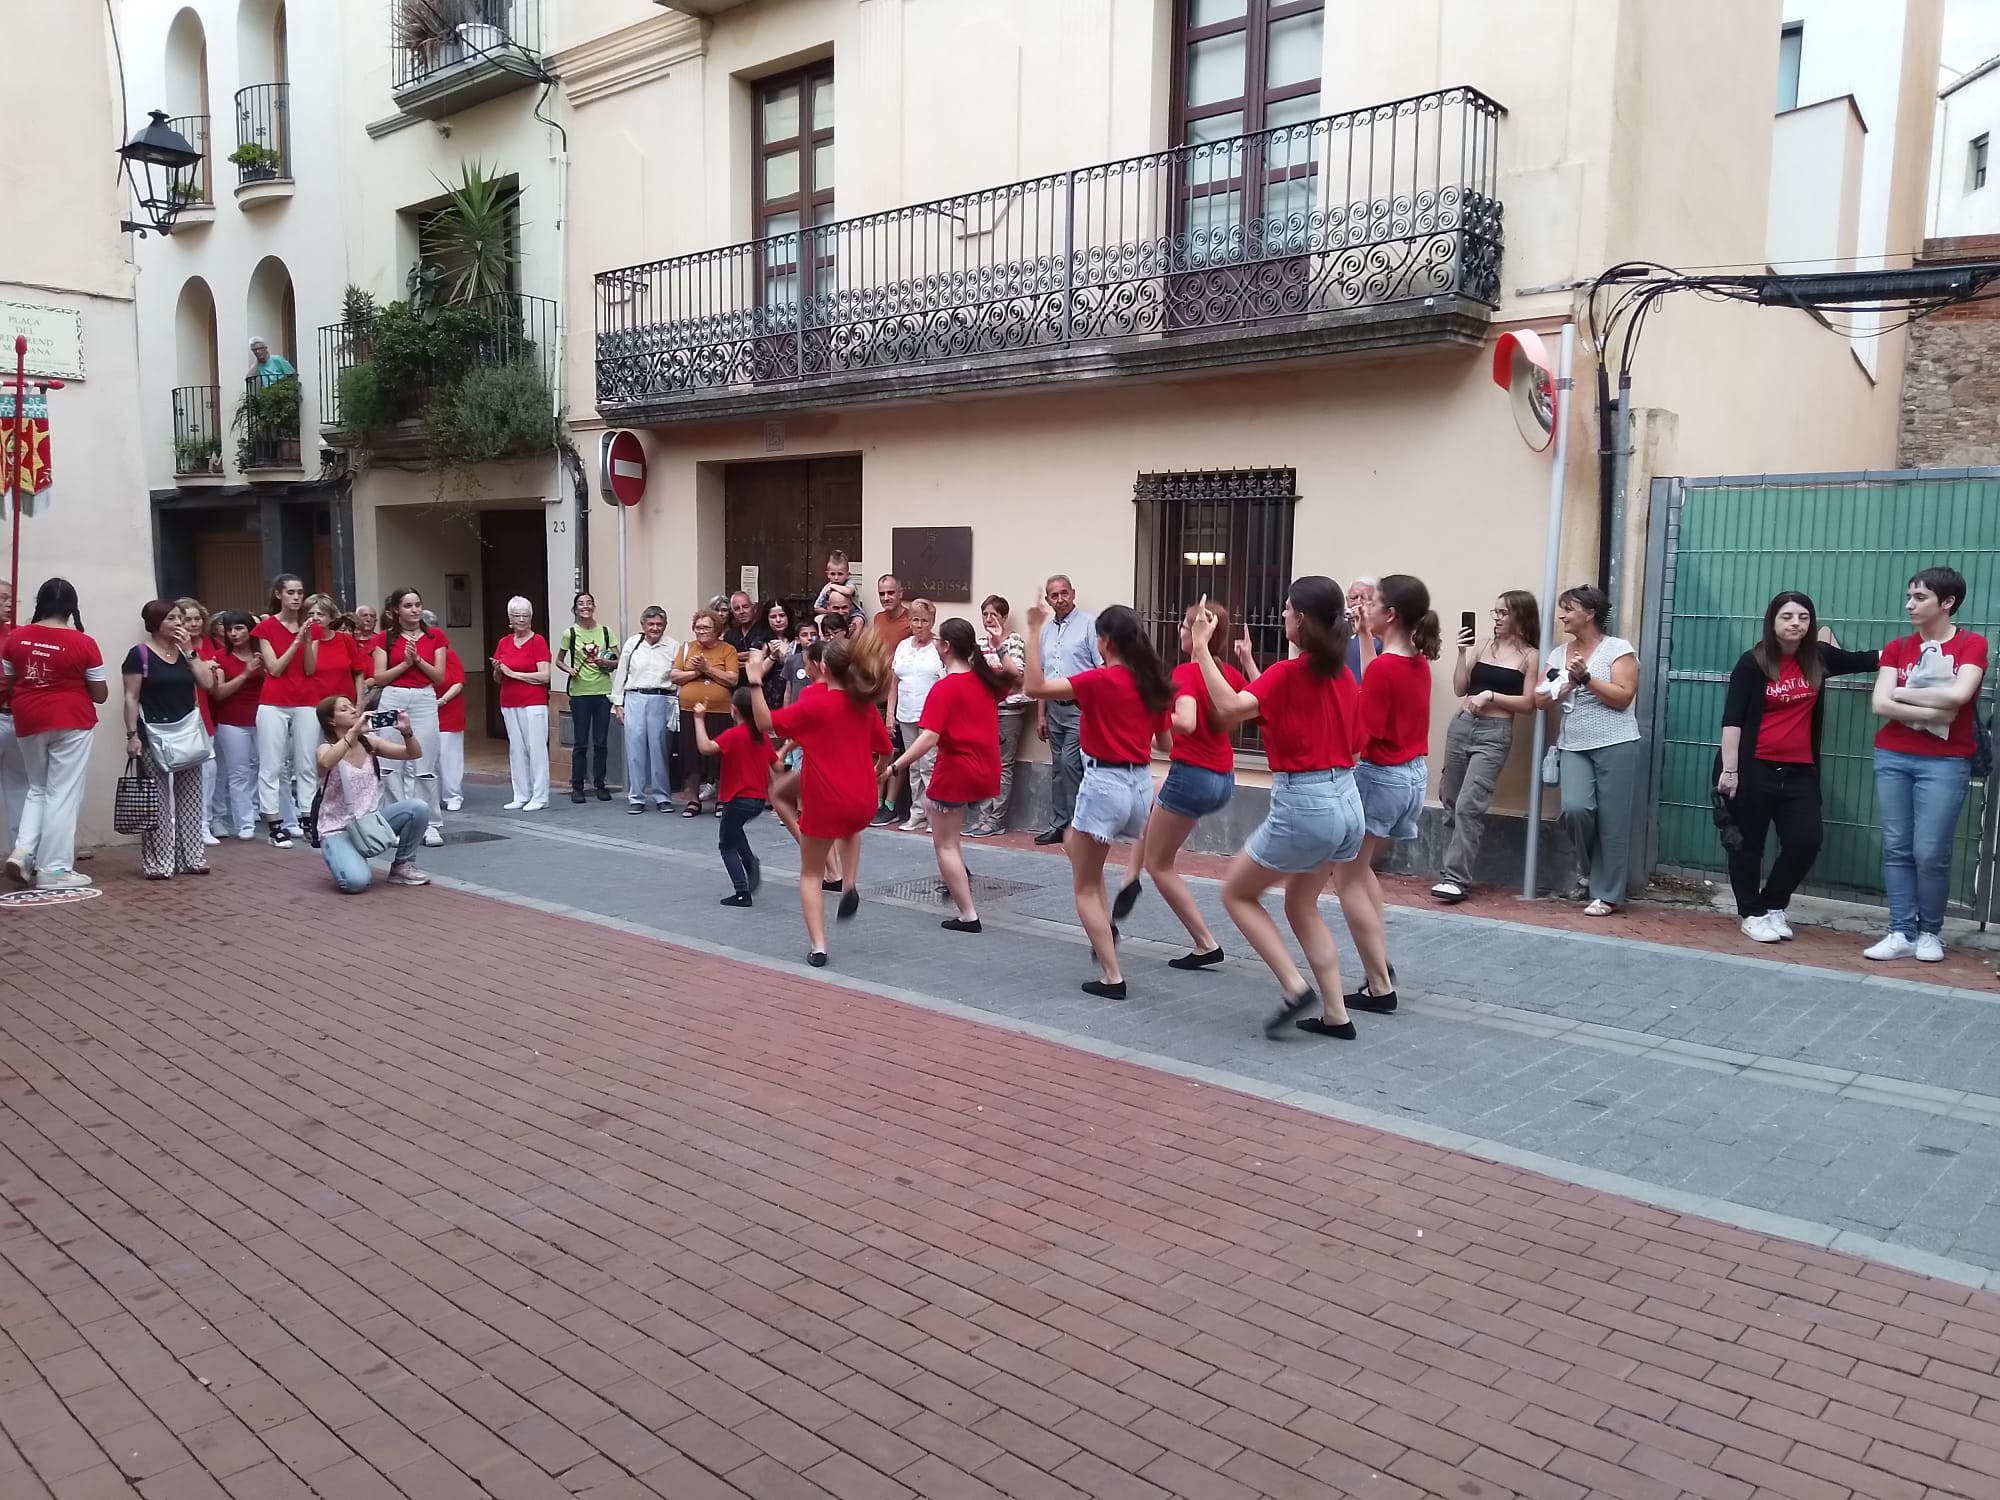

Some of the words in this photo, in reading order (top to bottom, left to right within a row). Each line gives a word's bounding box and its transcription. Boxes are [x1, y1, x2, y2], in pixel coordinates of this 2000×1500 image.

[8, 315, 41, 327] PLAÇA
[16, 326, 33, 335] DEL
[0, 334, 54, 346] REVREND
[553, 520, 566, 533] 23
